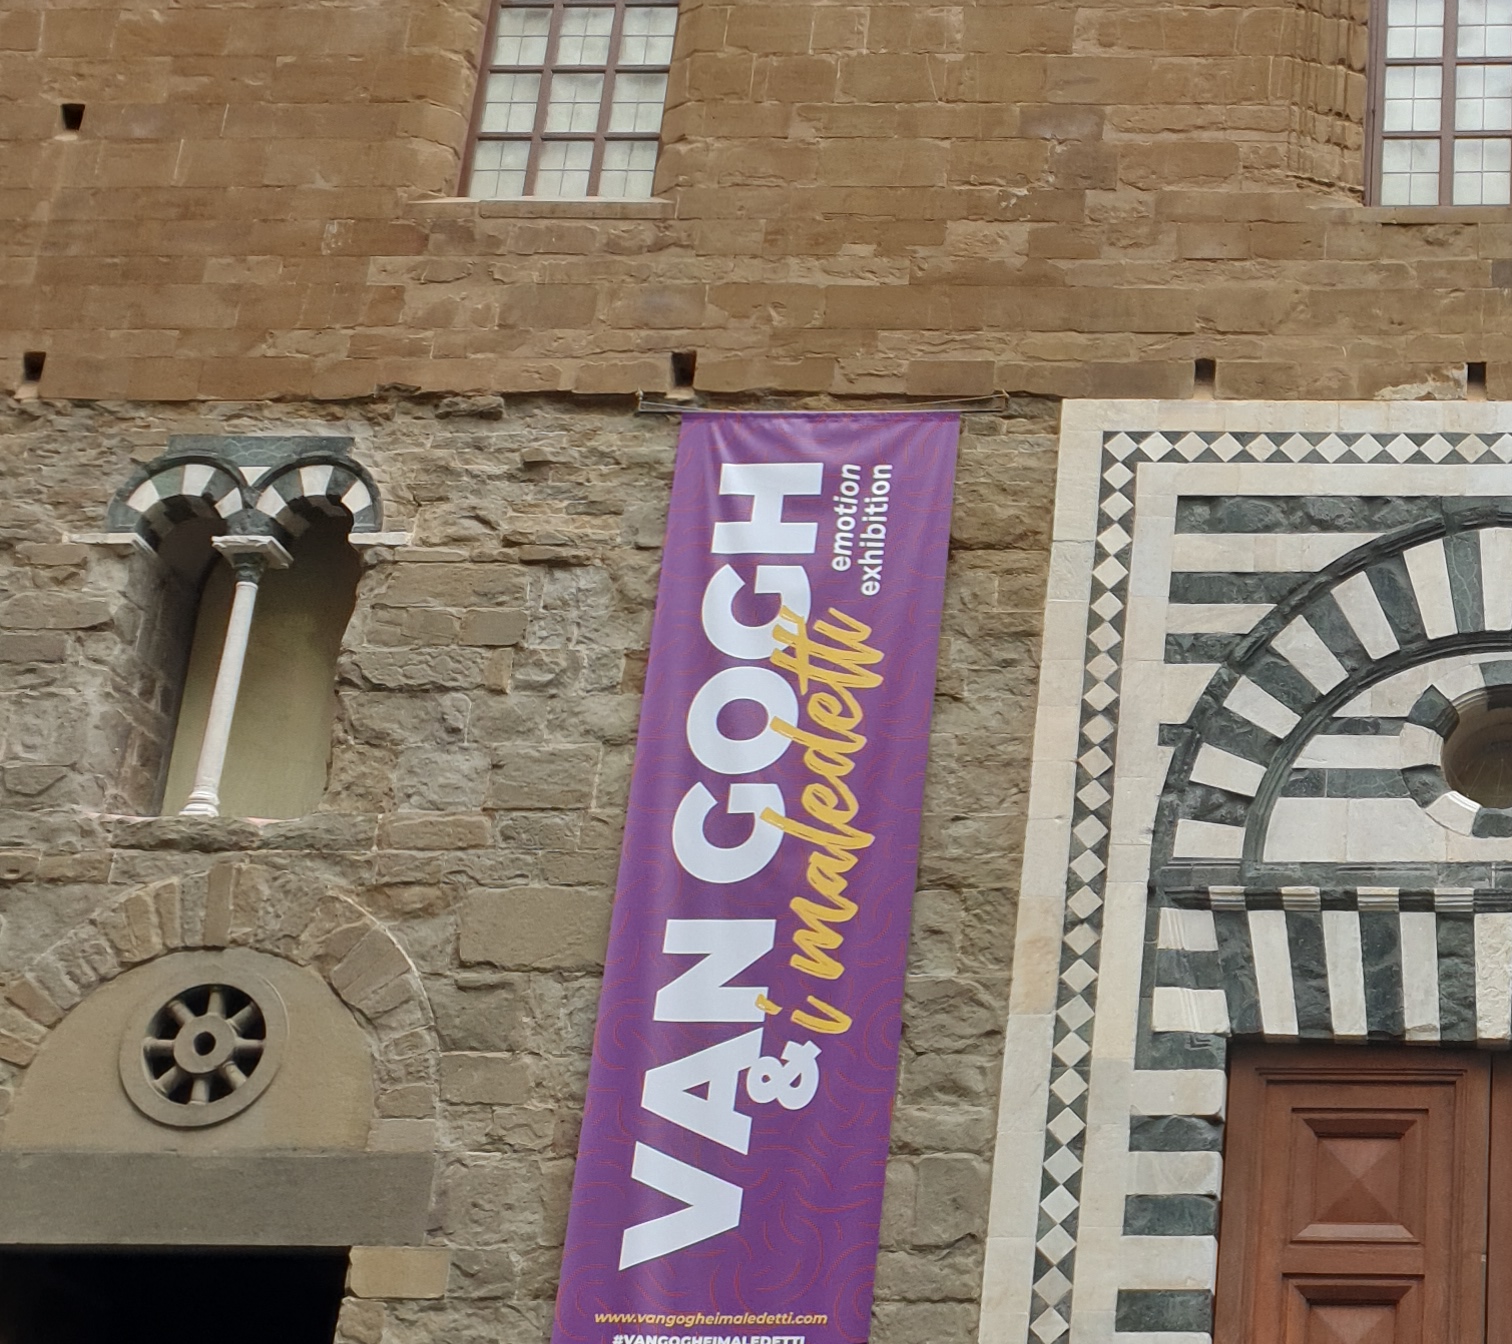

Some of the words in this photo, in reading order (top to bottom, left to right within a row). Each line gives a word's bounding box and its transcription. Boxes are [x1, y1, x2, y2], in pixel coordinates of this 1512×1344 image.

[832, 463, 861, 572] emotion
[861, 463, 893, 596] exhibition
[672, 462, 824, 884] GOGH
[760, 605, 884, 980] maledetti
[755, 994, 853, 1034] i
[619, 919, 777, 1271] VAN
[746, 1040, 822, 1110] &
[595, 1311, 828, 1327] www.vangogheimaledetti.com
